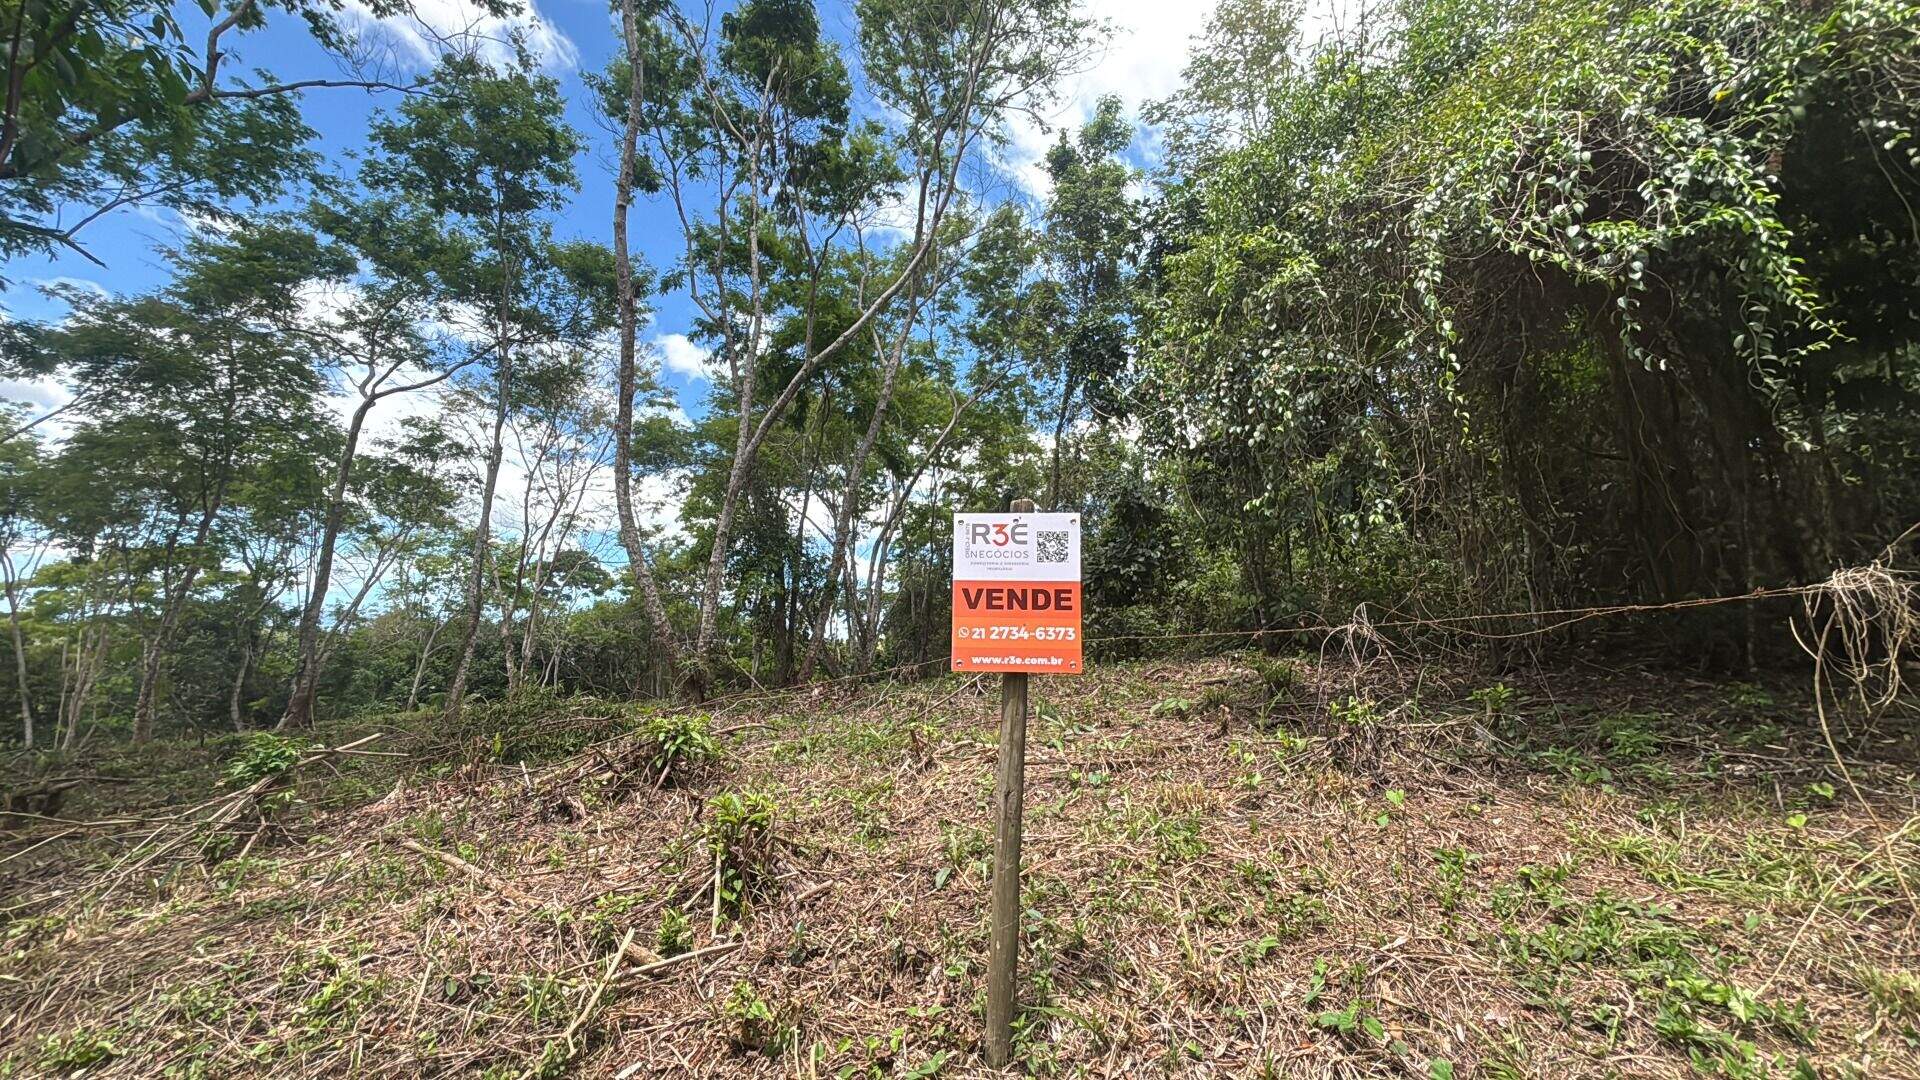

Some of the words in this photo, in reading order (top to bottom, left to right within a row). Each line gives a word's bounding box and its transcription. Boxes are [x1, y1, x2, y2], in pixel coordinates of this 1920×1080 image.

[971, 523, 1028, 547] R3E
[970, 549, 1029, 559] NEGÓCIOS
[961, 588, 1073, 611] VENDE
[971, 627, 986, 639] 21
[989, 626, 1076, 640] 2734-6373
[971, 656, 1064, 666] www.r3e.com.br
